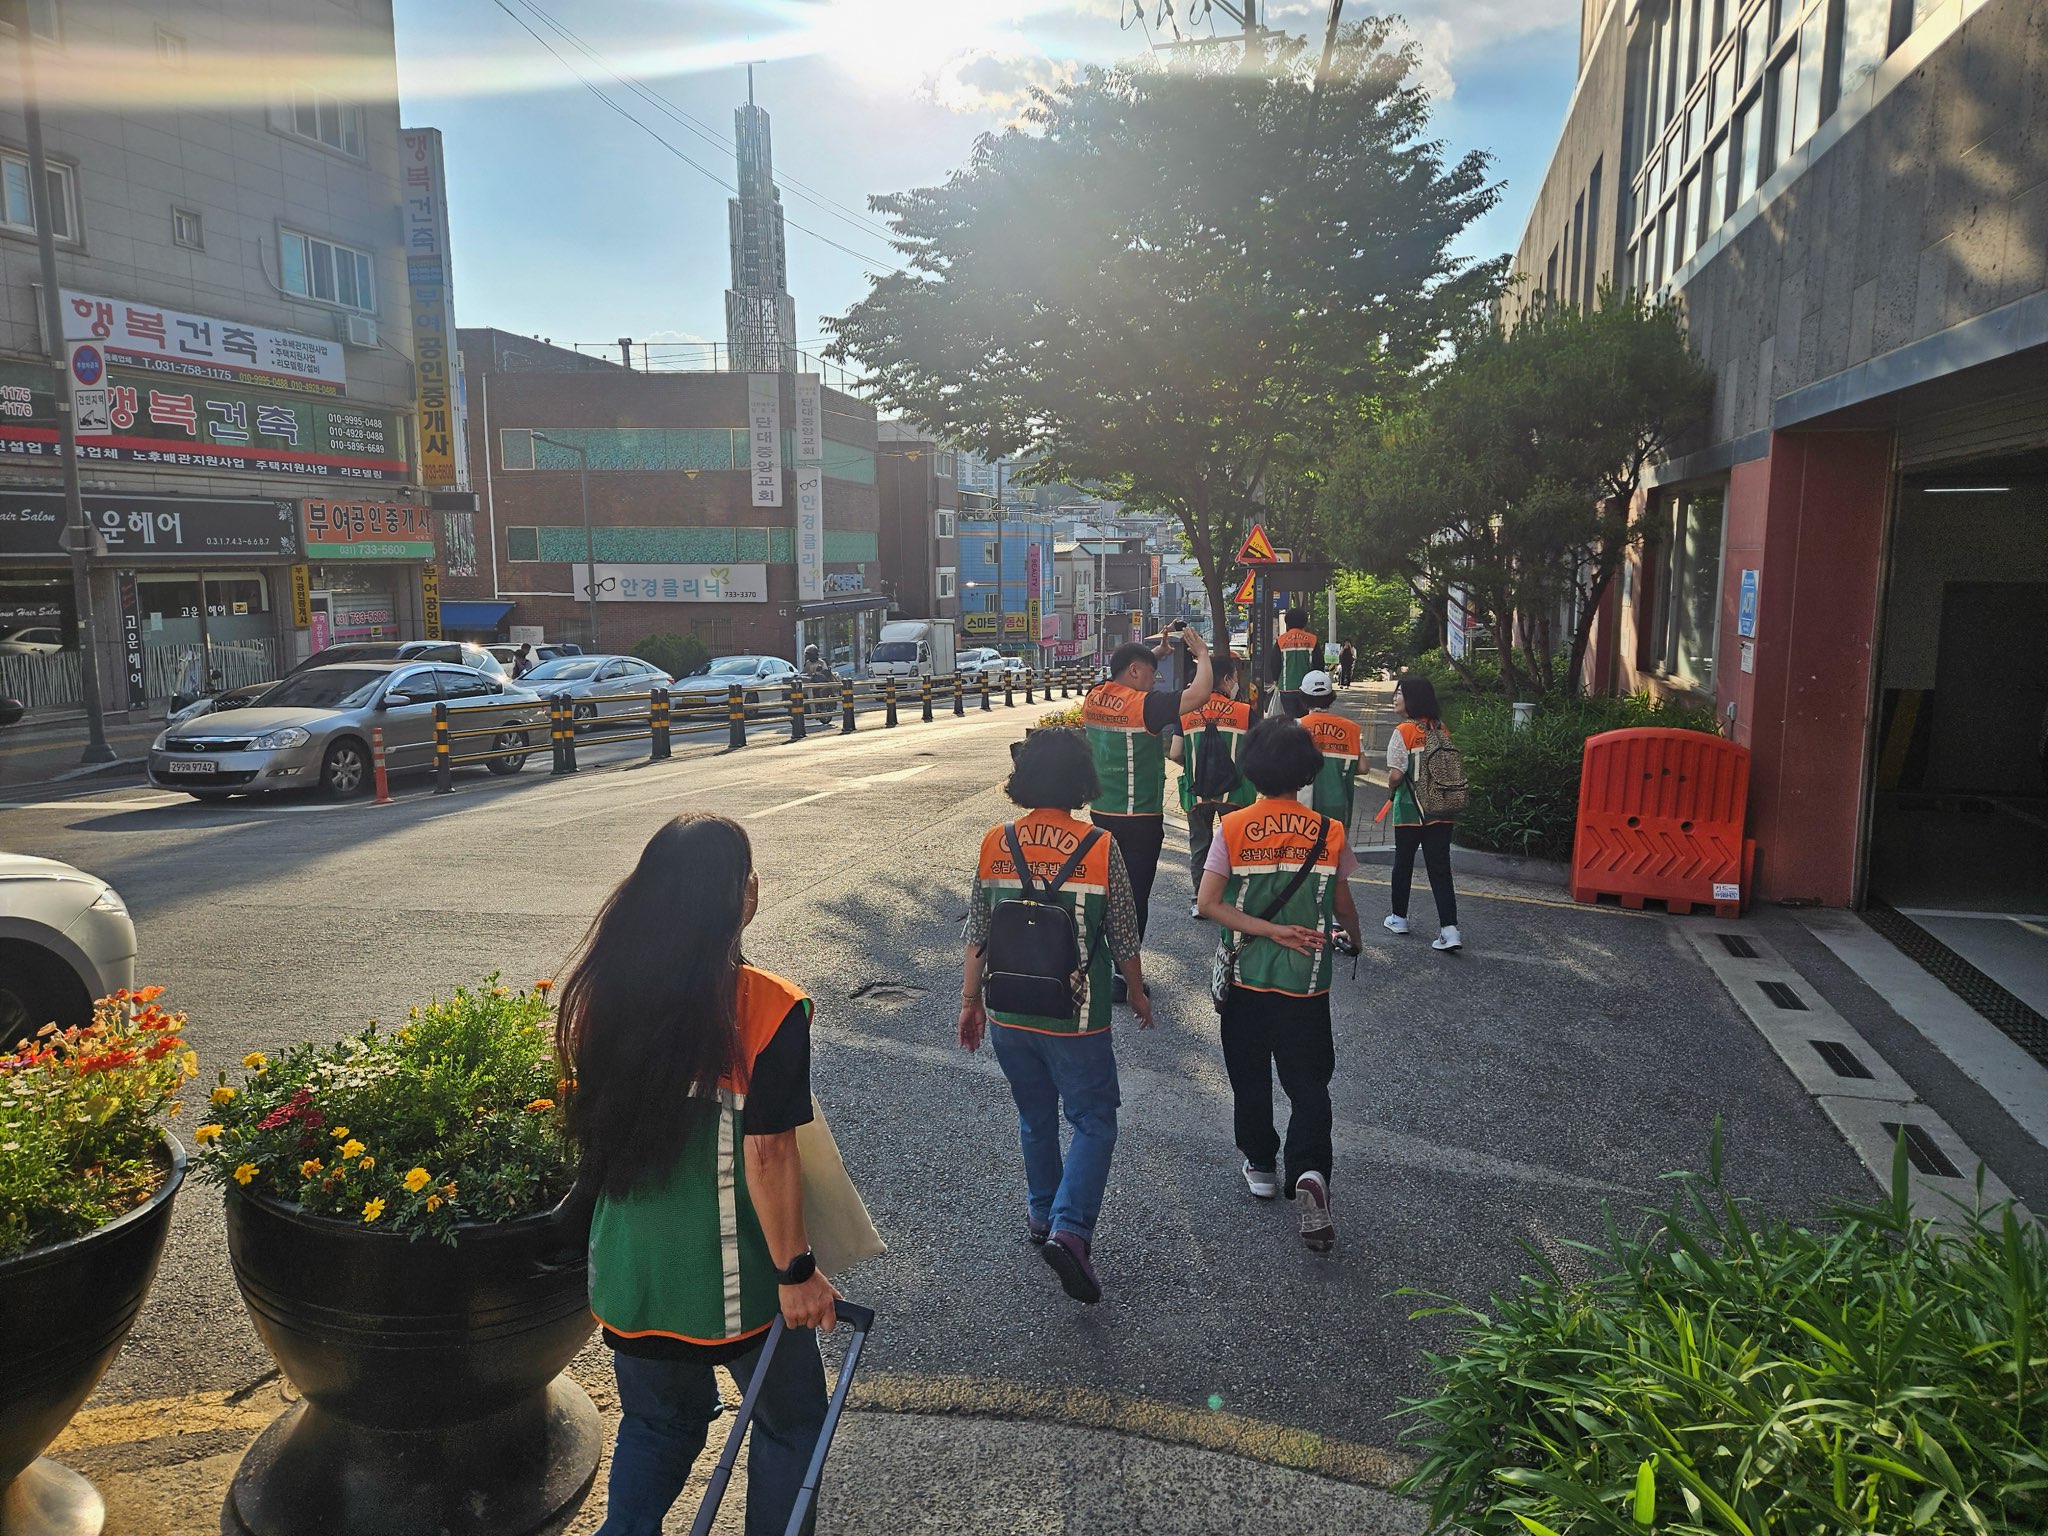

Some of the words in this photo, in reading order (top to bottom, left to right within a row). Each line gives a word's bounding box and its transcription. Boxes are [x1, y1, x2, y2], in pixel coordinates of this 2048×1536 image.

[71, 299, 257, 364] 행복건축
[328, 413, 382, 429] 010-9995-0488
[329, 426, 384, 441] 010-4928-0488
[132, 450, 244, 469] 노후배관지원사업
[256, 460, 327, 475] 주택지원사업
[341, 467, 382, 479] 리모델링
[20, 508, 56, 522] Salon
[309, 503, 431, 540] 부여공인중개사
[86, 510, 183, 544] 운헤어
[359, 544, 406, 555] 733-5600
[801, 495, 817, 591] 안경클리닉
[620, 578, 721, 598] 안경클리닉
[181, 606, 199, 618] 고운
[208, 605, 226, 616] 헤어
[967, 616, 1025, 629] 스마트동산
[125, 615, 142, 688] 고운헤어
[1309, 722, 1346, 741] AIND
[1244, 814, 1321, 842] CAIND
[1240, 845, 1329, 861] 성남시자율방단
[991, 859, 1087, 878] 성남자율방단
